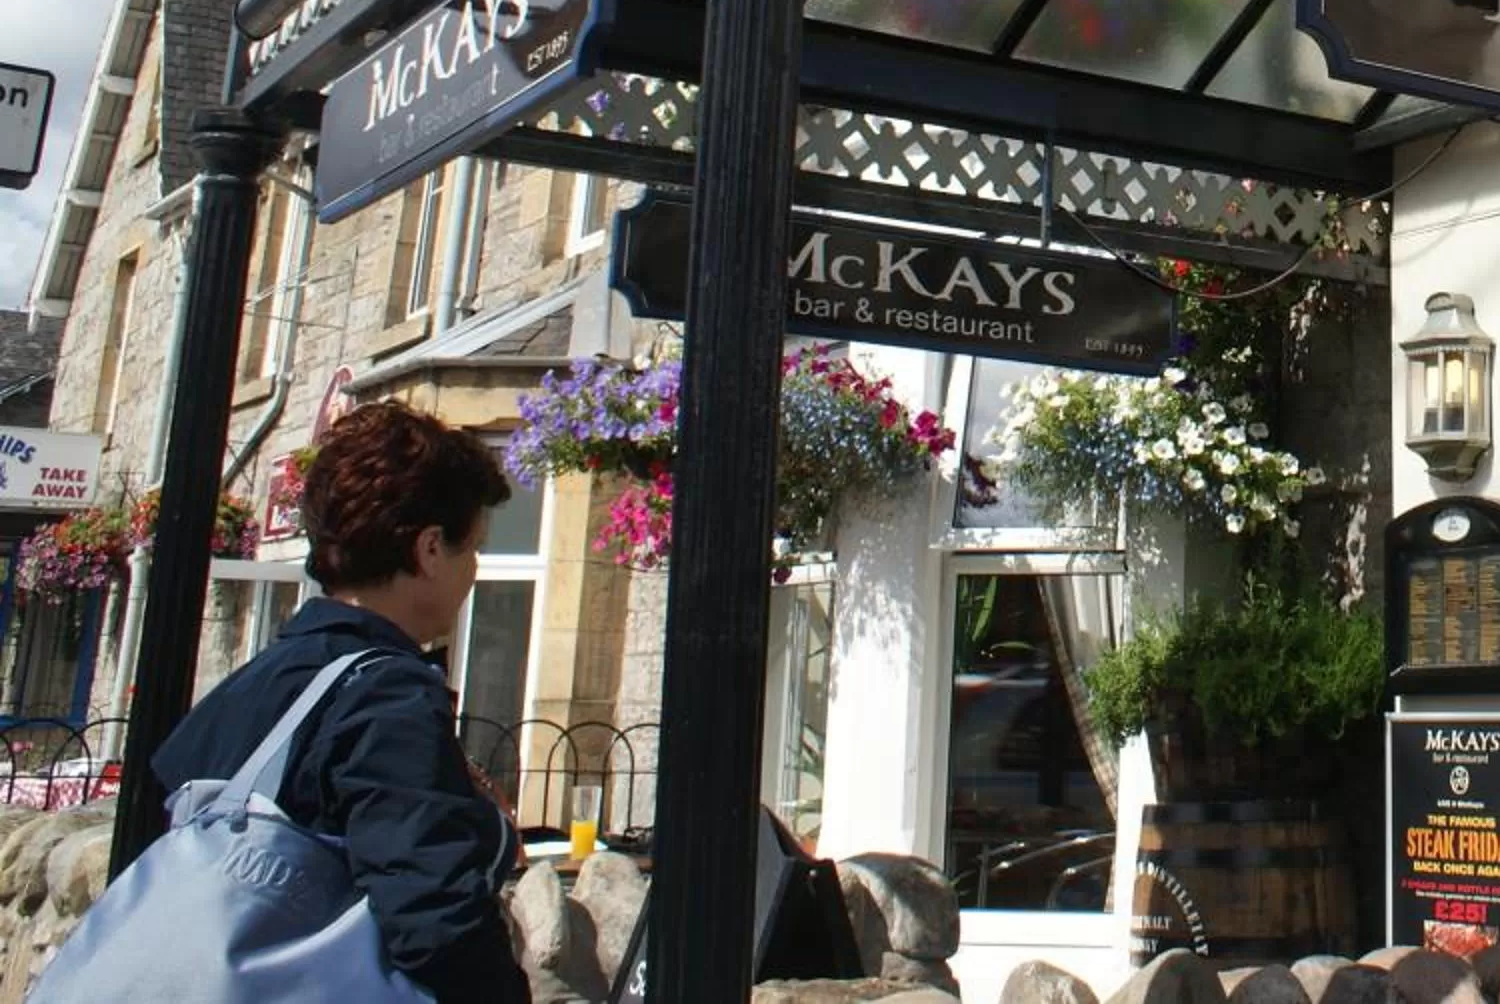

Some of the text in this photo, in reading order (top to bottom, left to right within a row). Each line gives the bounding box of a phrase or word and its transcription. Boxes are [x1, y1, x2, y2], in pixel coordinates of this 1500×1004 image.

[794, 289, 1033, 344] bar & restaurant
[40, 467, 87, 483] TAKE
[32, 483, 88, 499] AWAY
[1427, 815, 1497, 828] THE FAMOUS
[1407, 828, 1455, 860] STEAK
[1413, 861, 1442, 874] BACK
[1443, 863, 1475, 876] ONCE
